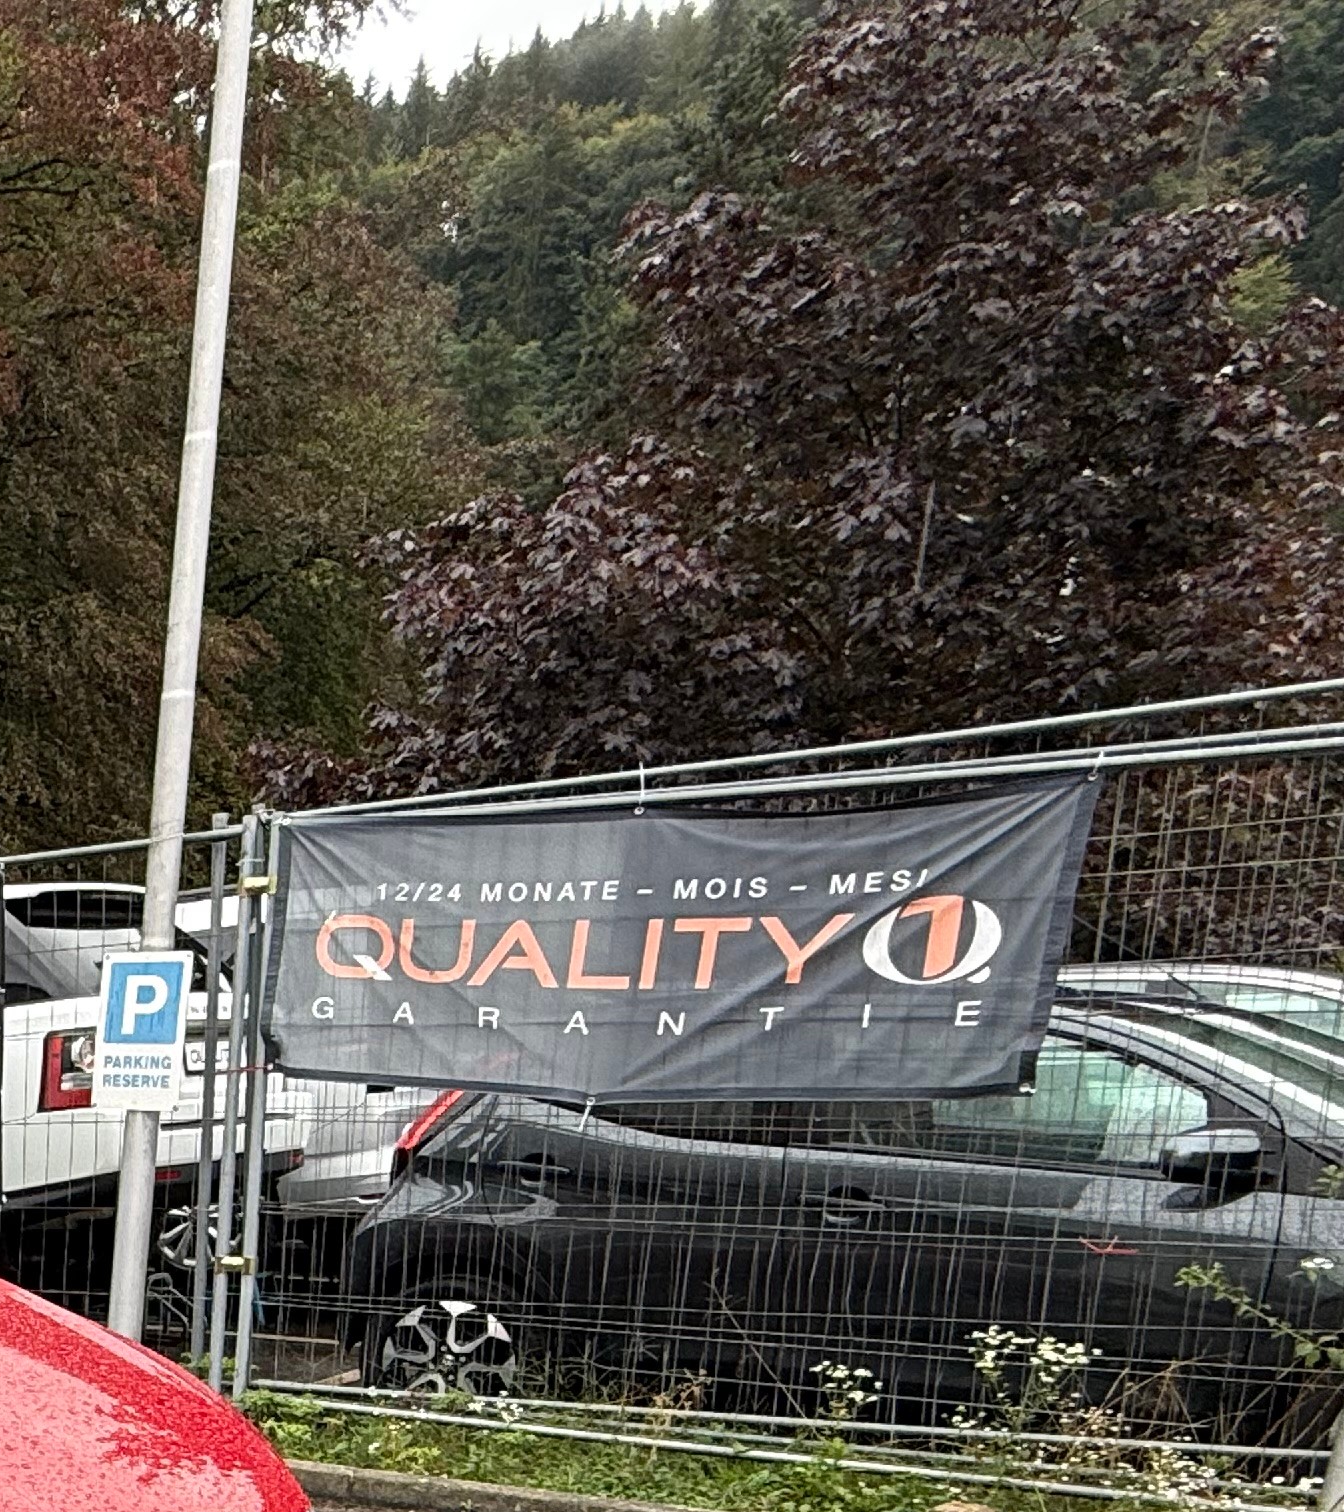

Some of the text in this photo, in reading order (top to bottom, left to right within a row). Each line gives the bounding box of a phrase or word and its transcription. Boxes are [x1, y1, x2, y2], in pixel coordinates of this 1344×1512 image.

[376, 882, 463, 903] 12/24
[480, 879, 620, 903] MONATE
[673, 877, 769, 900] MOIS
[315, 911, 855, 990] QUALITY
[120, 974, 169, 1035] P
[311, 996, 983, 1036] GARANTIE
[103, 1054, 172, 1070] PARKING
[102, 1073, 170, 1089] RESERVE
